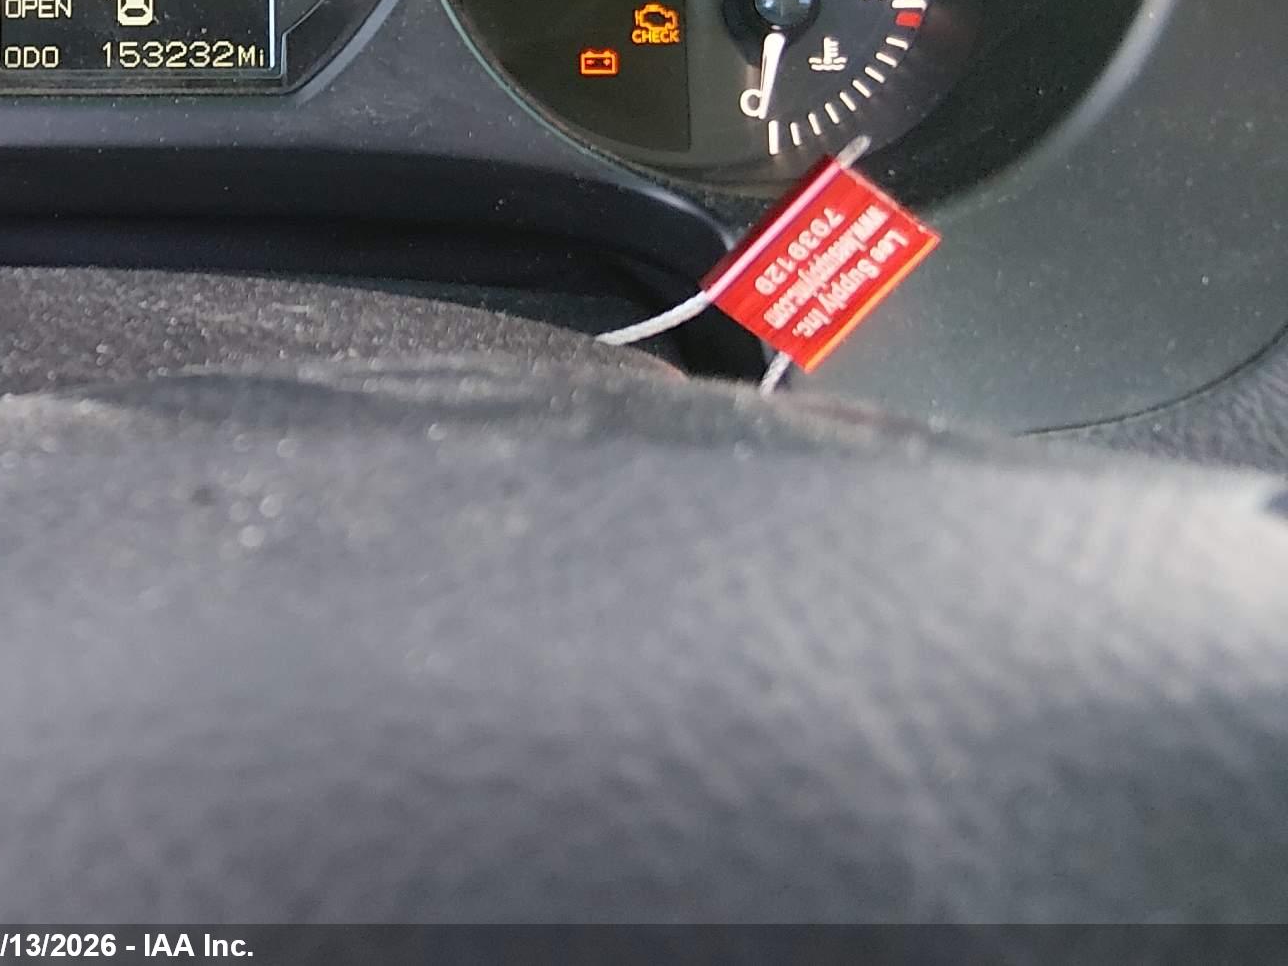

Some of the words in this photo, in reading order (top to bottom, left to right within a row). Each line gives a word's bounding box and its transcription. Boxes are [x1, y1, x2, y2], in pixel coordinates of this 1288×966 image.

[631, 28, 680, 44] CHECK
[4, 46, 59, 68] ODO
[869, 230, 909, 263] Lee
[818, 257, 880, 311] Supply
[792, 309, 831, 338] Inc.
